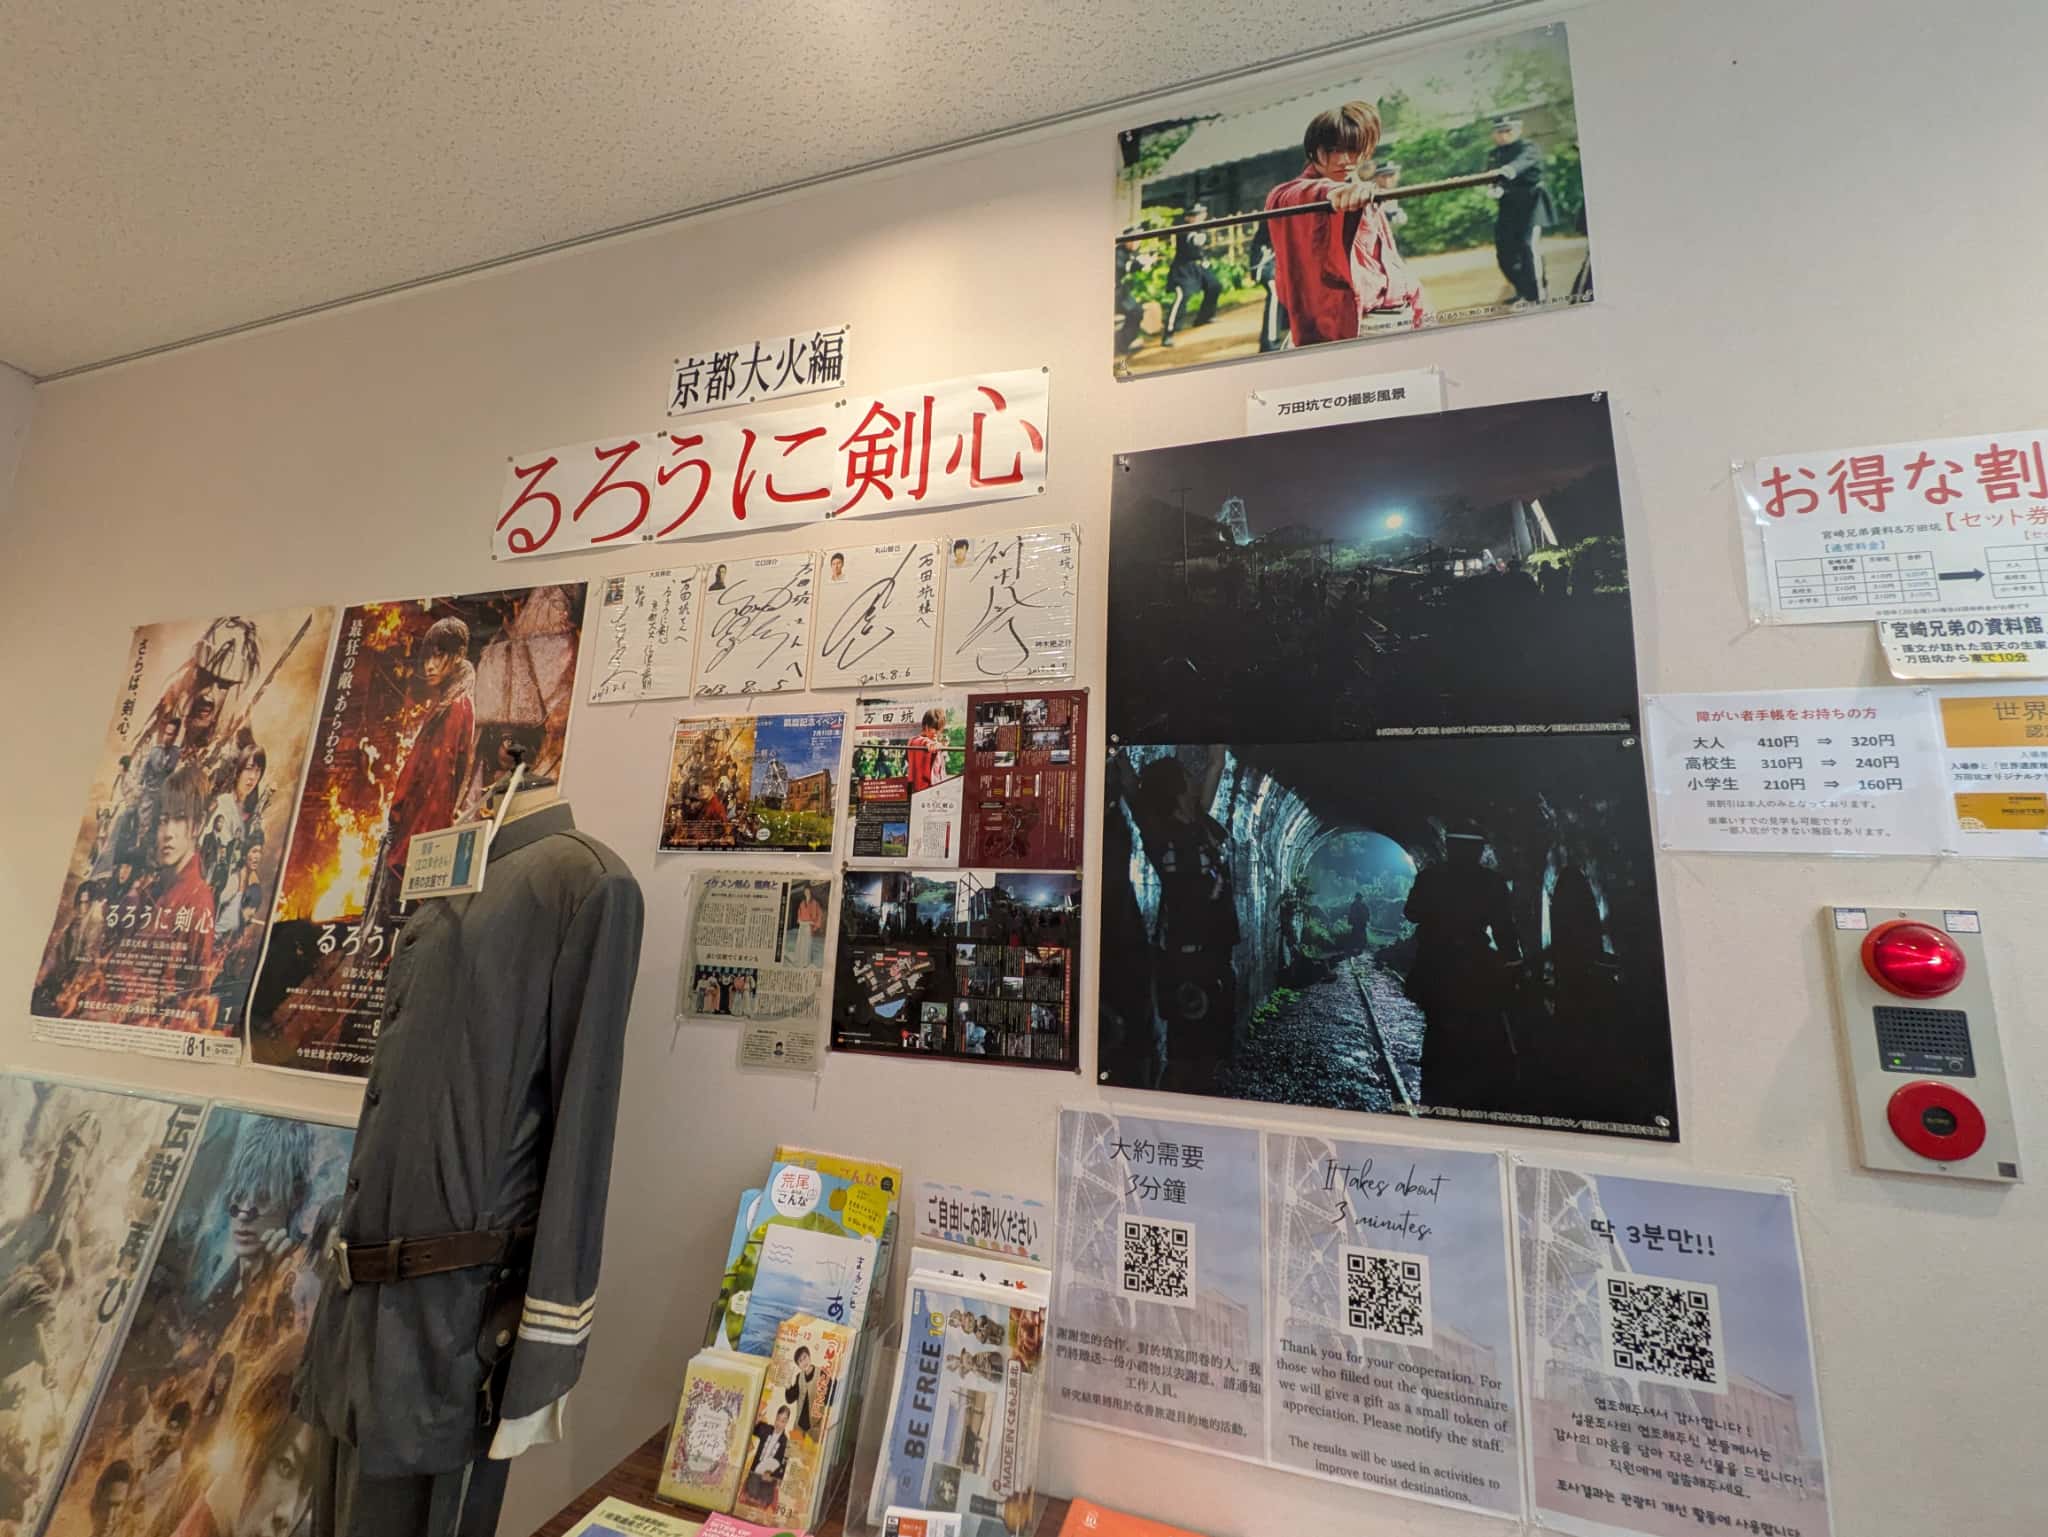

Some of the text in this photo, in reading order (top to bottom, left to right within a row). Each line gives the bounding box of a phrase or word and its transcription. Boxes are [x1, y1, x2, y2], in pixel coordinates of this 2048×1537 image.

[671, 328, 846, 409] 京都大火編
[1277, 387, 1406, 416] 万田坑での撮影風景
[496, 385, 1043, 554] るろうに剣心
[1761, 440, 2048, 518] お得な割
[1880, 616, 2048, 638] 「宮崎兄弟の資料館
[863, 709, 915, 724] 万田坑
[1696, 707, 1879, 722] 障がい者手帳をお持ちの方
[1692, 733, 1896, 750] 大人 410円 320円
[1684, 755, 1900, 771] 高校生 310円 240円
[1687, 776, 1903, 791] 小学生 210円 160円
[106, 904, 214, 934] るろうに剣心
[1110, 1136, 1205, 1171] 大約需要
[782, 1172, 810, 1190] 荒尾
[1124, 1174, 1188, 1205] 3分鐘
[1342, 1158, 1390, 1200] takes
[1395, 1163, 1451, 1205] about
[928, 1194, 1038, 1247] ご自由にお取りください
[1332, 1201, 1348, 1224] 3
[1591, 1218, 1715, 1256] 딱 3분만!!
[913, 1341, 942, 1412] FREE
[1280, 1338, 1502, 1390] Thank you for your cooperation. For
[1276, 1358, 1508, 1412] those who filled out the questionnaire
[1279, 1380, 1508, 1432] we will give a gift as a small token of
[1674, 1410, 1742, 1434] 감사합니다
[903, 1418, 930, 1460] BE
[1006, 1428, 1016, 1446] IN
[1282, 1400, 1504, 1454] appreciation. Please notify the staff.
[1001, 1449, 1016, 1489] MADE
[1288, 1434, 1500, 1490] The results will be used in activities to
[1553, 1428, 1591, 1446] 감사의
[1596, 1437, 1632, 1455] 마음을
[1637, 1443, 1663, 1459] 담아
[1669, 1450, 1695, 1467] 작은
[1700, 1457, 1738, 1478] 선물을
[1608, 1459, 1662, 1479] 직원에게
[1315, 1459, 1472, 1503] improve tourist destinations.
[1557, 1479, 1616, 1503] 조사결과는
[1661, 1500, 1688, 1518] 개선
[1692, 1507, 1731, 1526] 활동에
